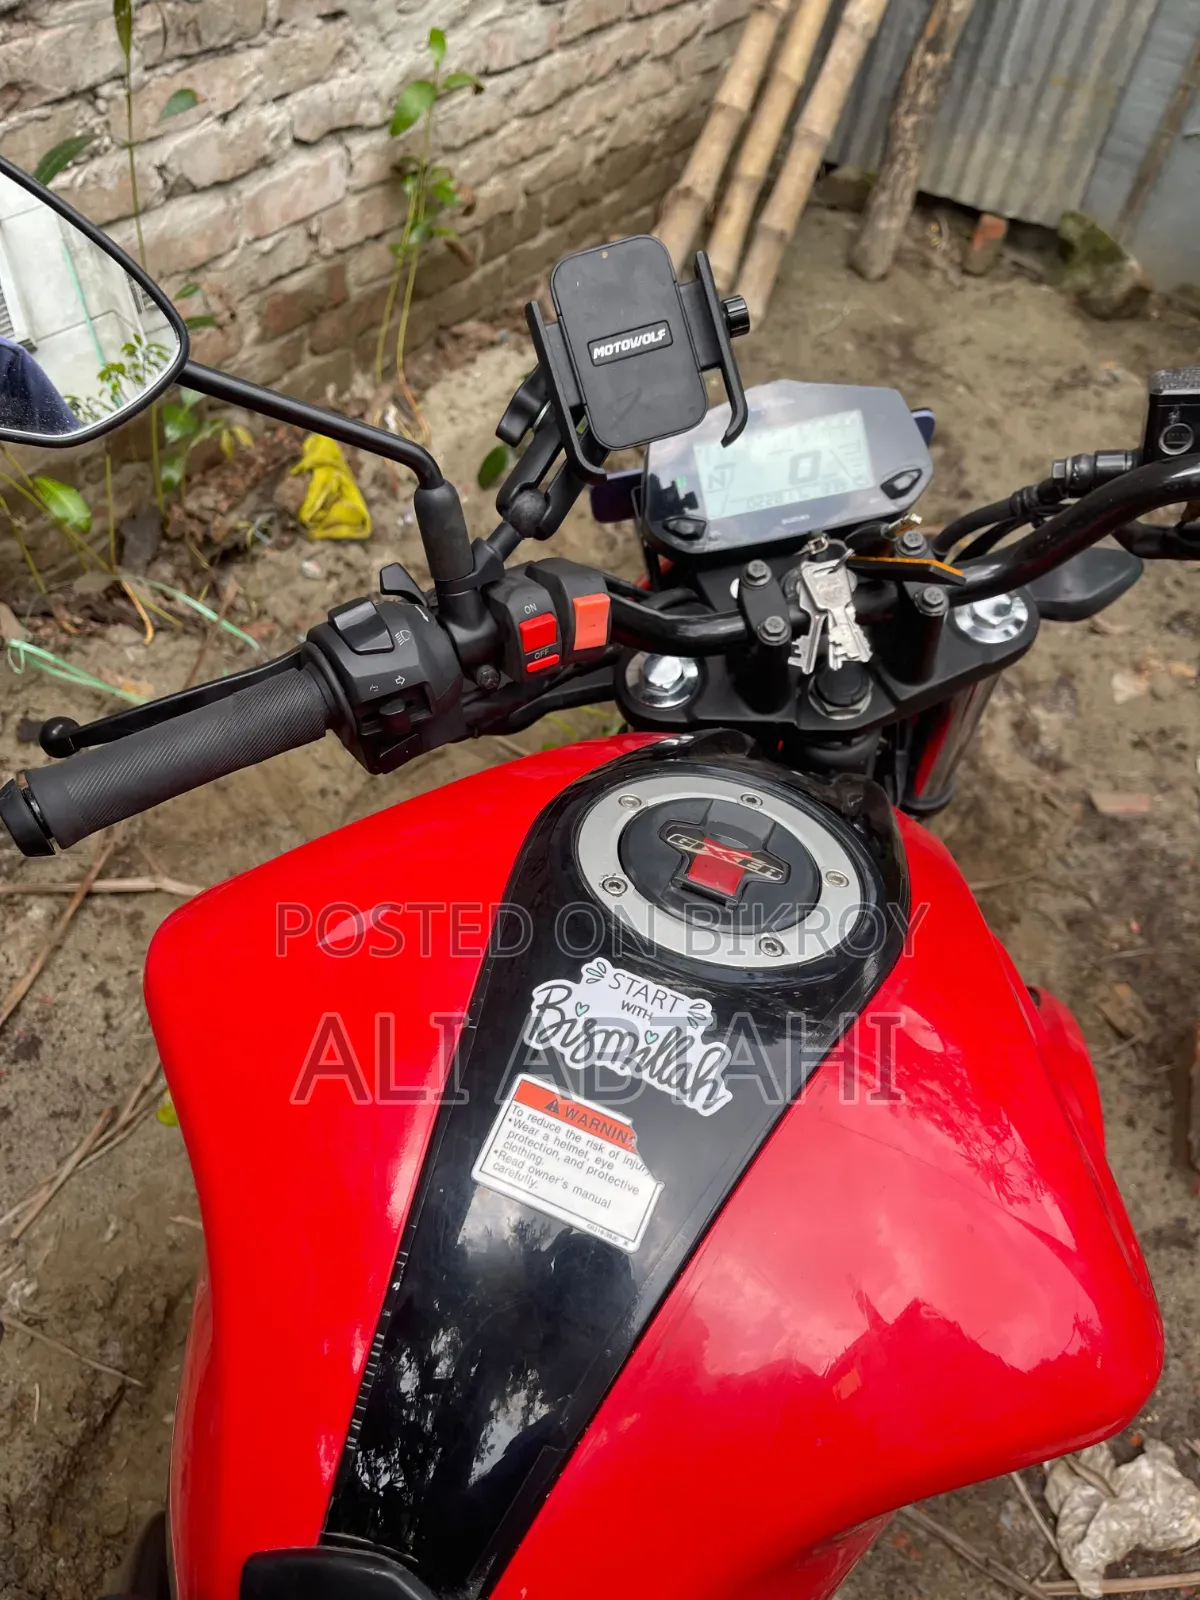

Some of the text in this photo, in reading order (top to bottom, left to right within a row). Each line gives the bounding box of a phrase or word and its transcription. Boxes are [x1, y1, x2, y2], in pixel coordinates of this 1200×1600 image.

[593, 329, 666, 360] MOTOWOLF
[524, 603, 537, 615] ON
[534, 648, 549, 660] OFF
[608, 972, 684, 1013] START
[621, 1000, 652, 1020] WITH
[528, 984, 727, 1110] Bismillah
[512, 1105, 524, 1117] To
[527, 1113, 561, 1134] reduce
[565, 1129, 582, 1142] the
[586, 1139, 606, 1153] risk
[609, 1149, 620, 1160] of
[503, 1141, 544, 1166] clothing.
[506, 1130, 640, 1195] protection, and protective
[543, 1133, 550, 1141] a
[553, 1136, 590, 1161] helmet,
[595, 1156, 614, 1170] eye
[493, 1162, 538, 1189] carefully.
[528, 1165, 569, 1189] owner's
[572, 1185, 612, 1209] manual
